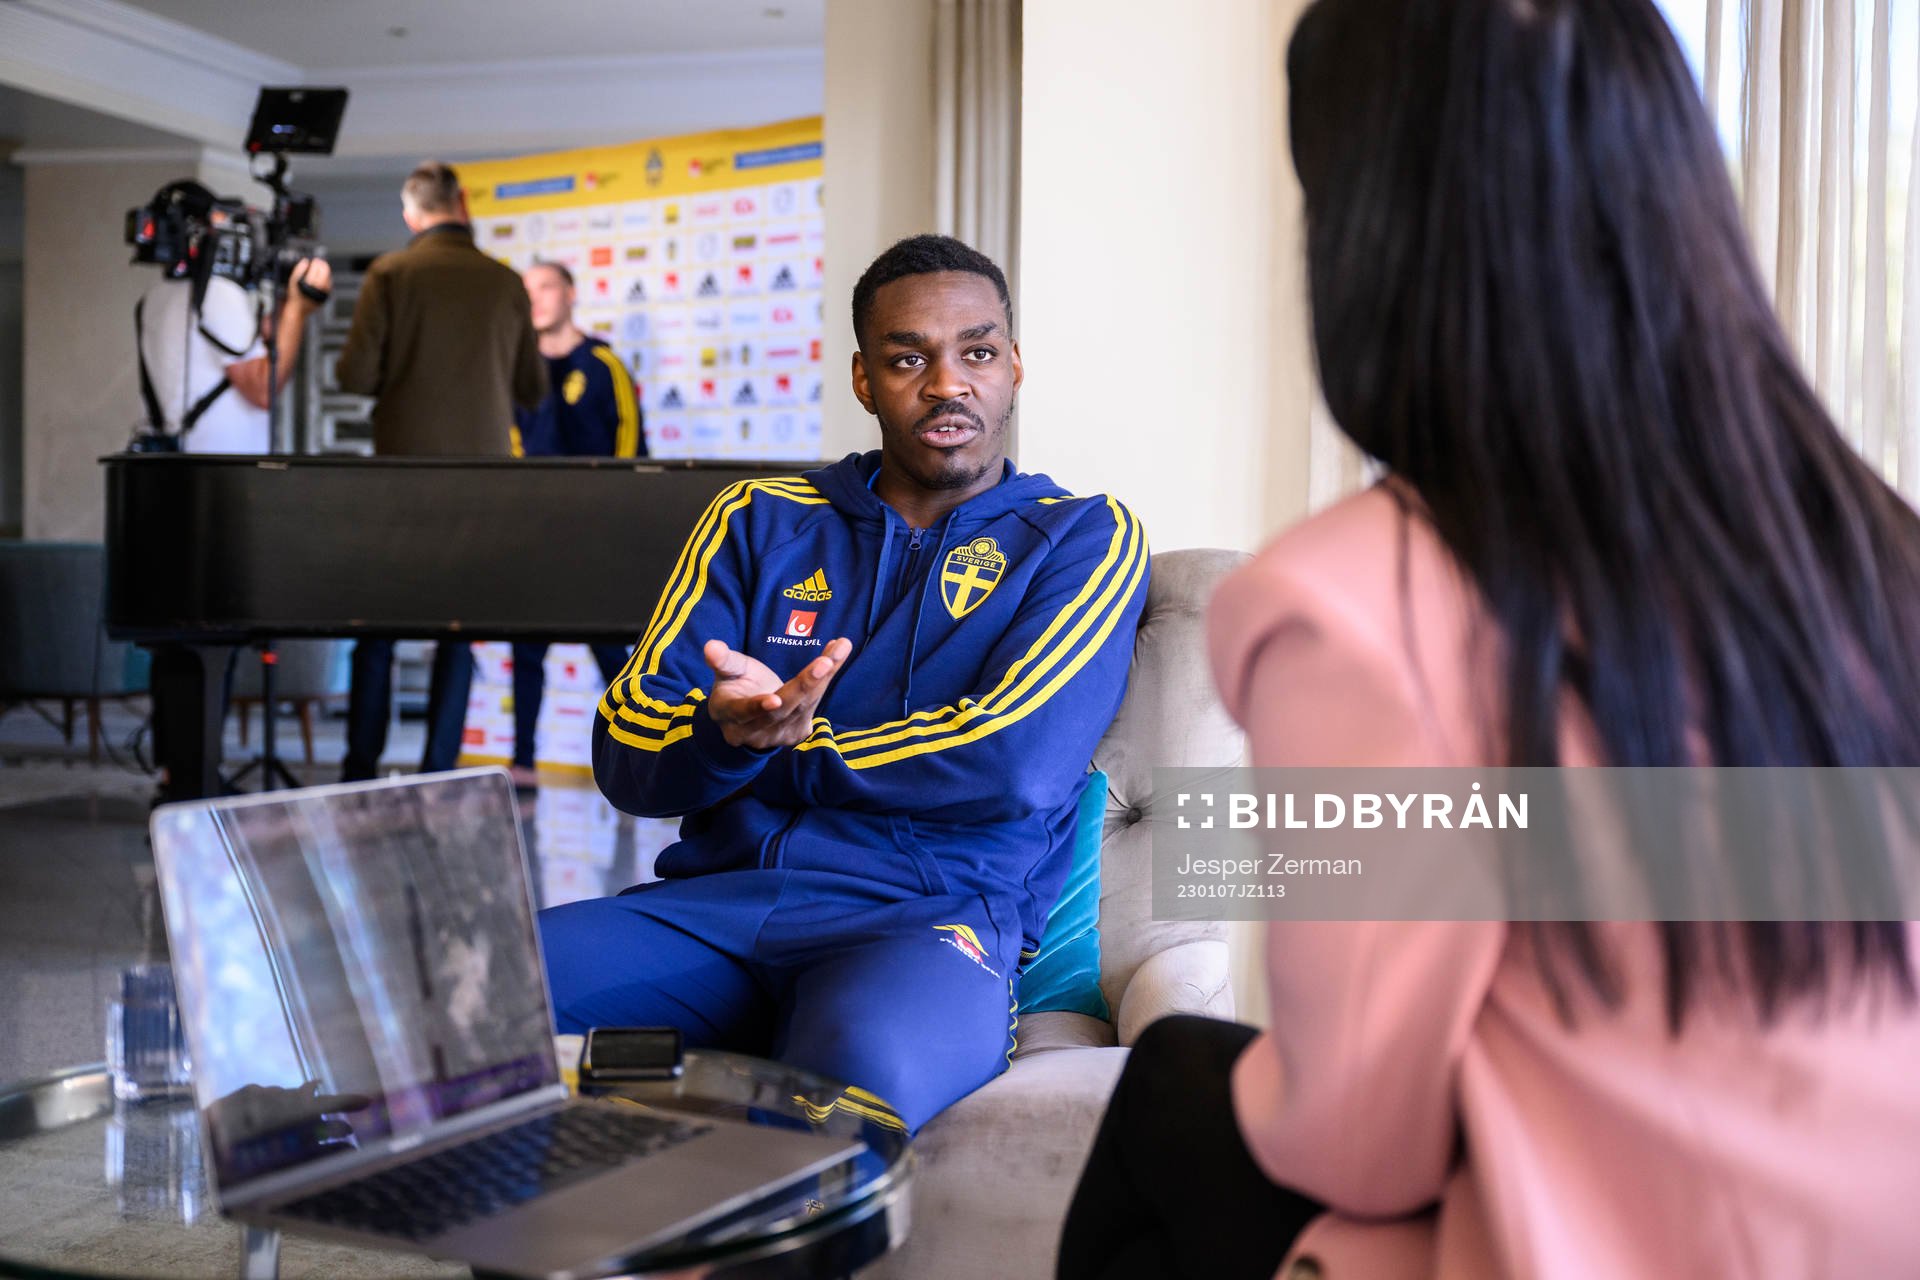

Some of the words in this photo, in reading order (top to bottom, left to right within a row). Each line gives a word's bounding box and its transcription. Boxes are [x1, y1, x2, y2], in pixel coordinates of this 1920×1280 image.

[955, 555, 997, 568] SVERIGE
[783, 587, 832, 601] adidas
[766, 636, 803, 647] SVENSKA
[804, 638, 822, 647] SPEL
